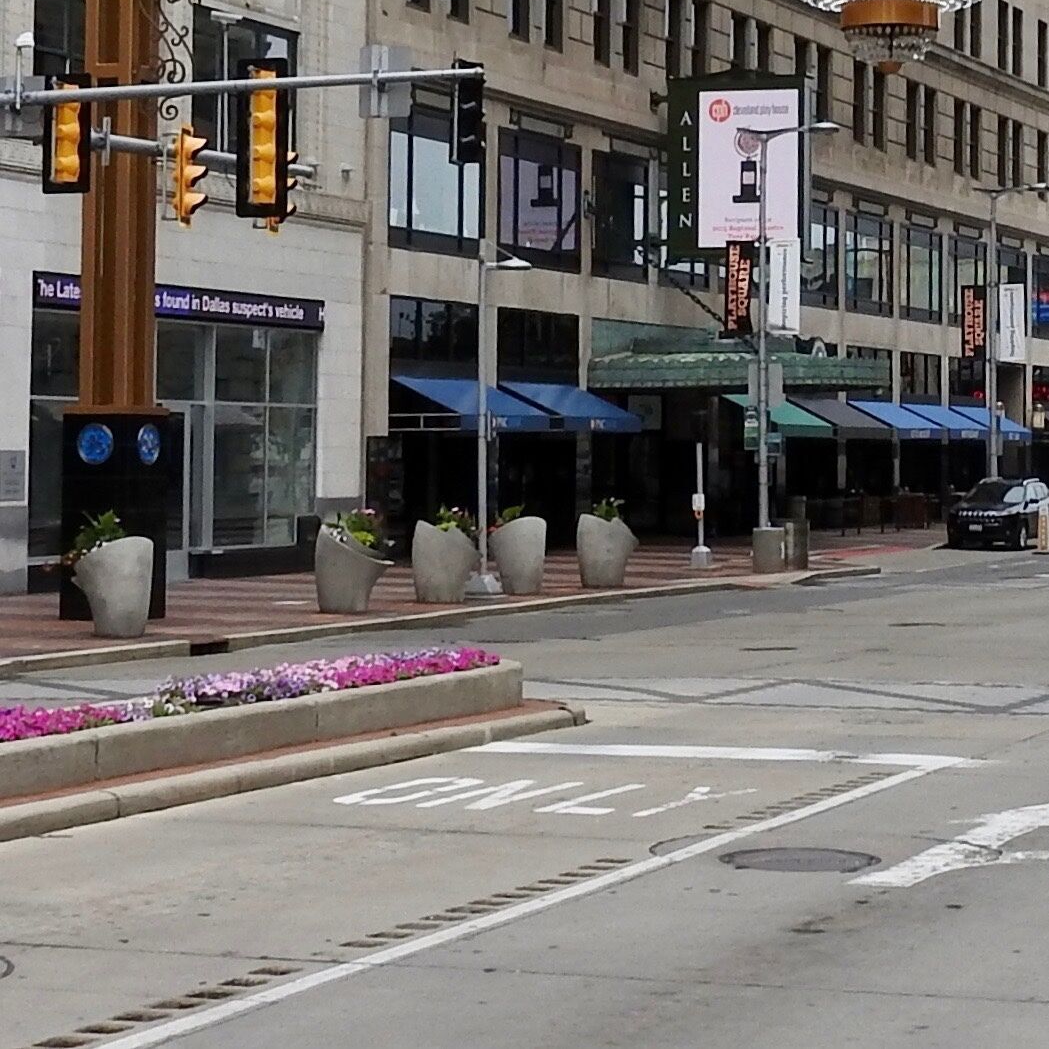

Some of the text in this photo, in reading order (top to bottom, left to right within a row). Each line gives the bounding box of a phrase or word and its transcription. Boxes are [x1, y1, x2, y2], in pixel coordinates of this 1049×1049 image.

[678, 110, 693, 229] ALLEN
[162, 292, 190, 310] found
[191, 294, 200, 311] in
[201, 295, 230, 314] Dallas
[232, 301, 274, 319] suspect's
[275, 302, 305, 321] vehicle
[727, 244, 740, 330] PLAYHOUSE
[737, 259, 751, 317] SQUARE
[964, 288, 975, 357] PLAYHOUSE
[974, 299, 984, 347] SQUARE
[332, 776, 758, 819] ONLY
